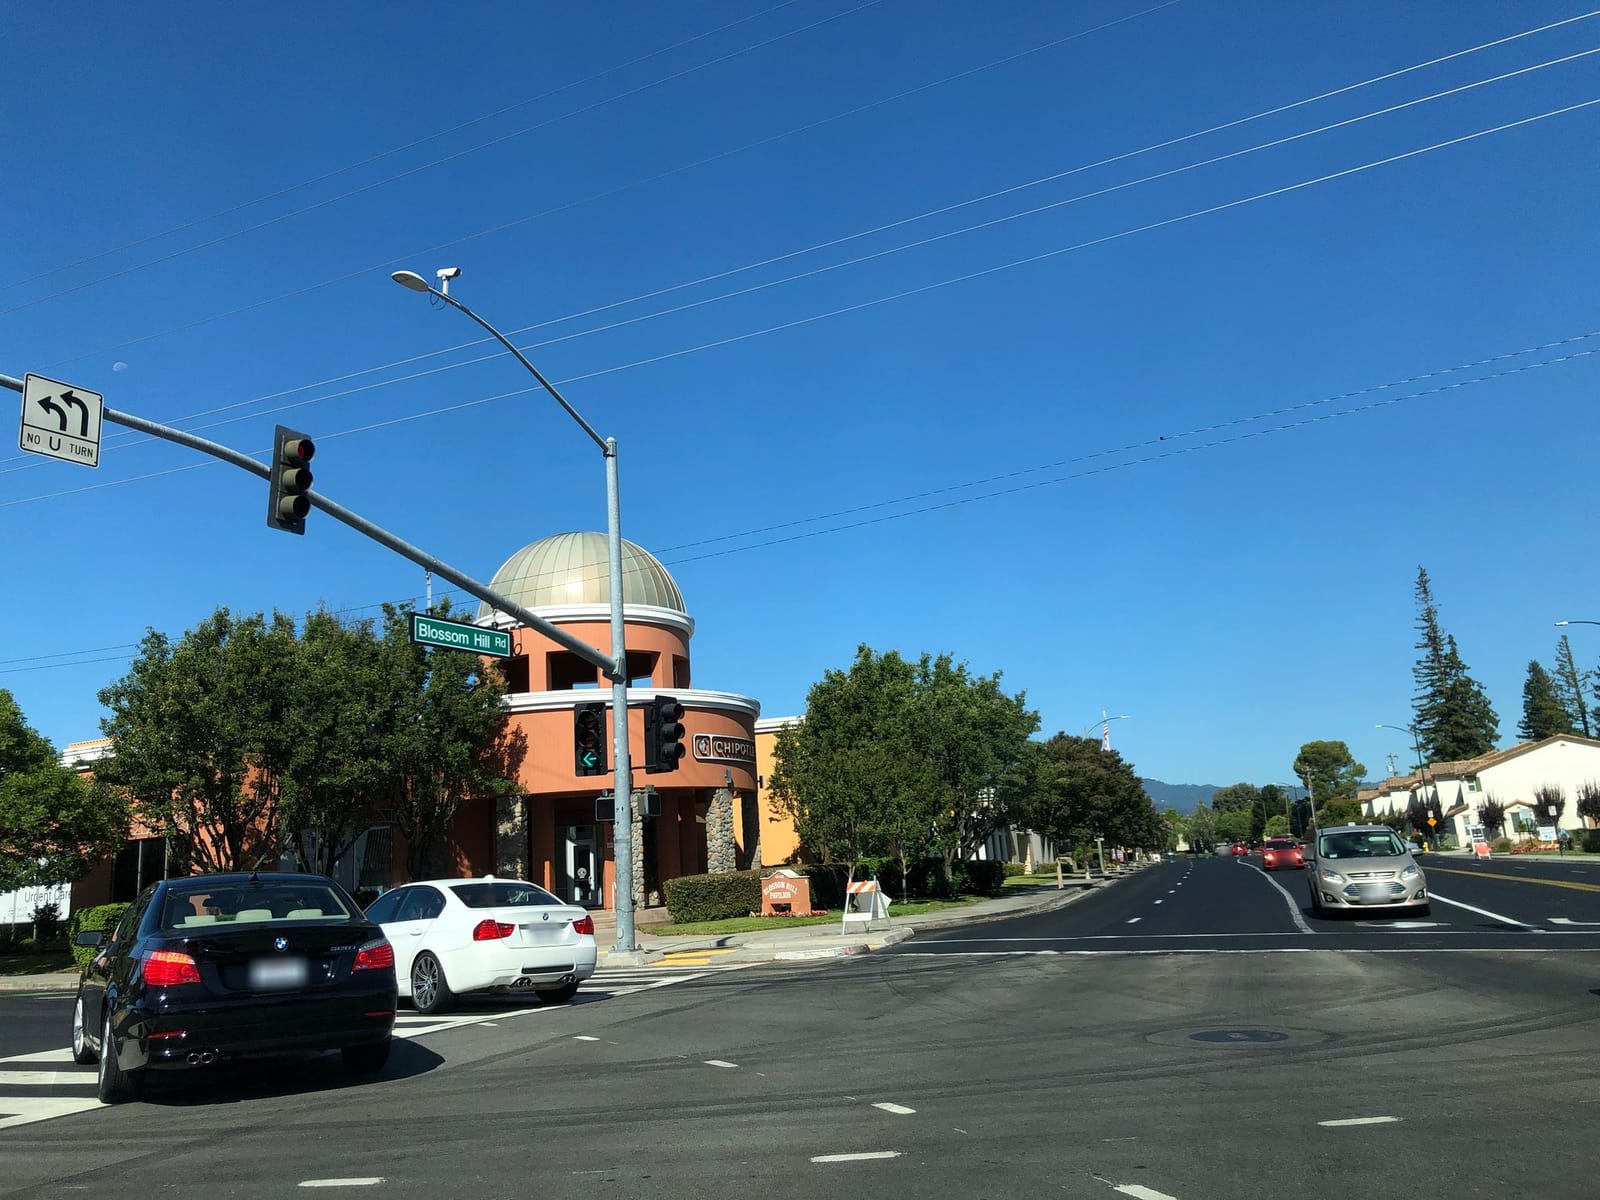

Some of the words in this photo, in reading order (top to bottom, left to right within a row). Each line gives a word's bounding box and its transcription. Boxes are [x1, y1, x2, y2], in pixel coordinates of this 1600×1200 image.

[26, 432, 41, 445] NO
[49, 436, 61, 451] U
[69, 443, 94, 458] TURN
[418, 623, 469, 644] Blossom
[474, 633, 490, 648] Hill
[495, 637, 506, 648] Rd
[25, 891, 51, 904] Urgent
